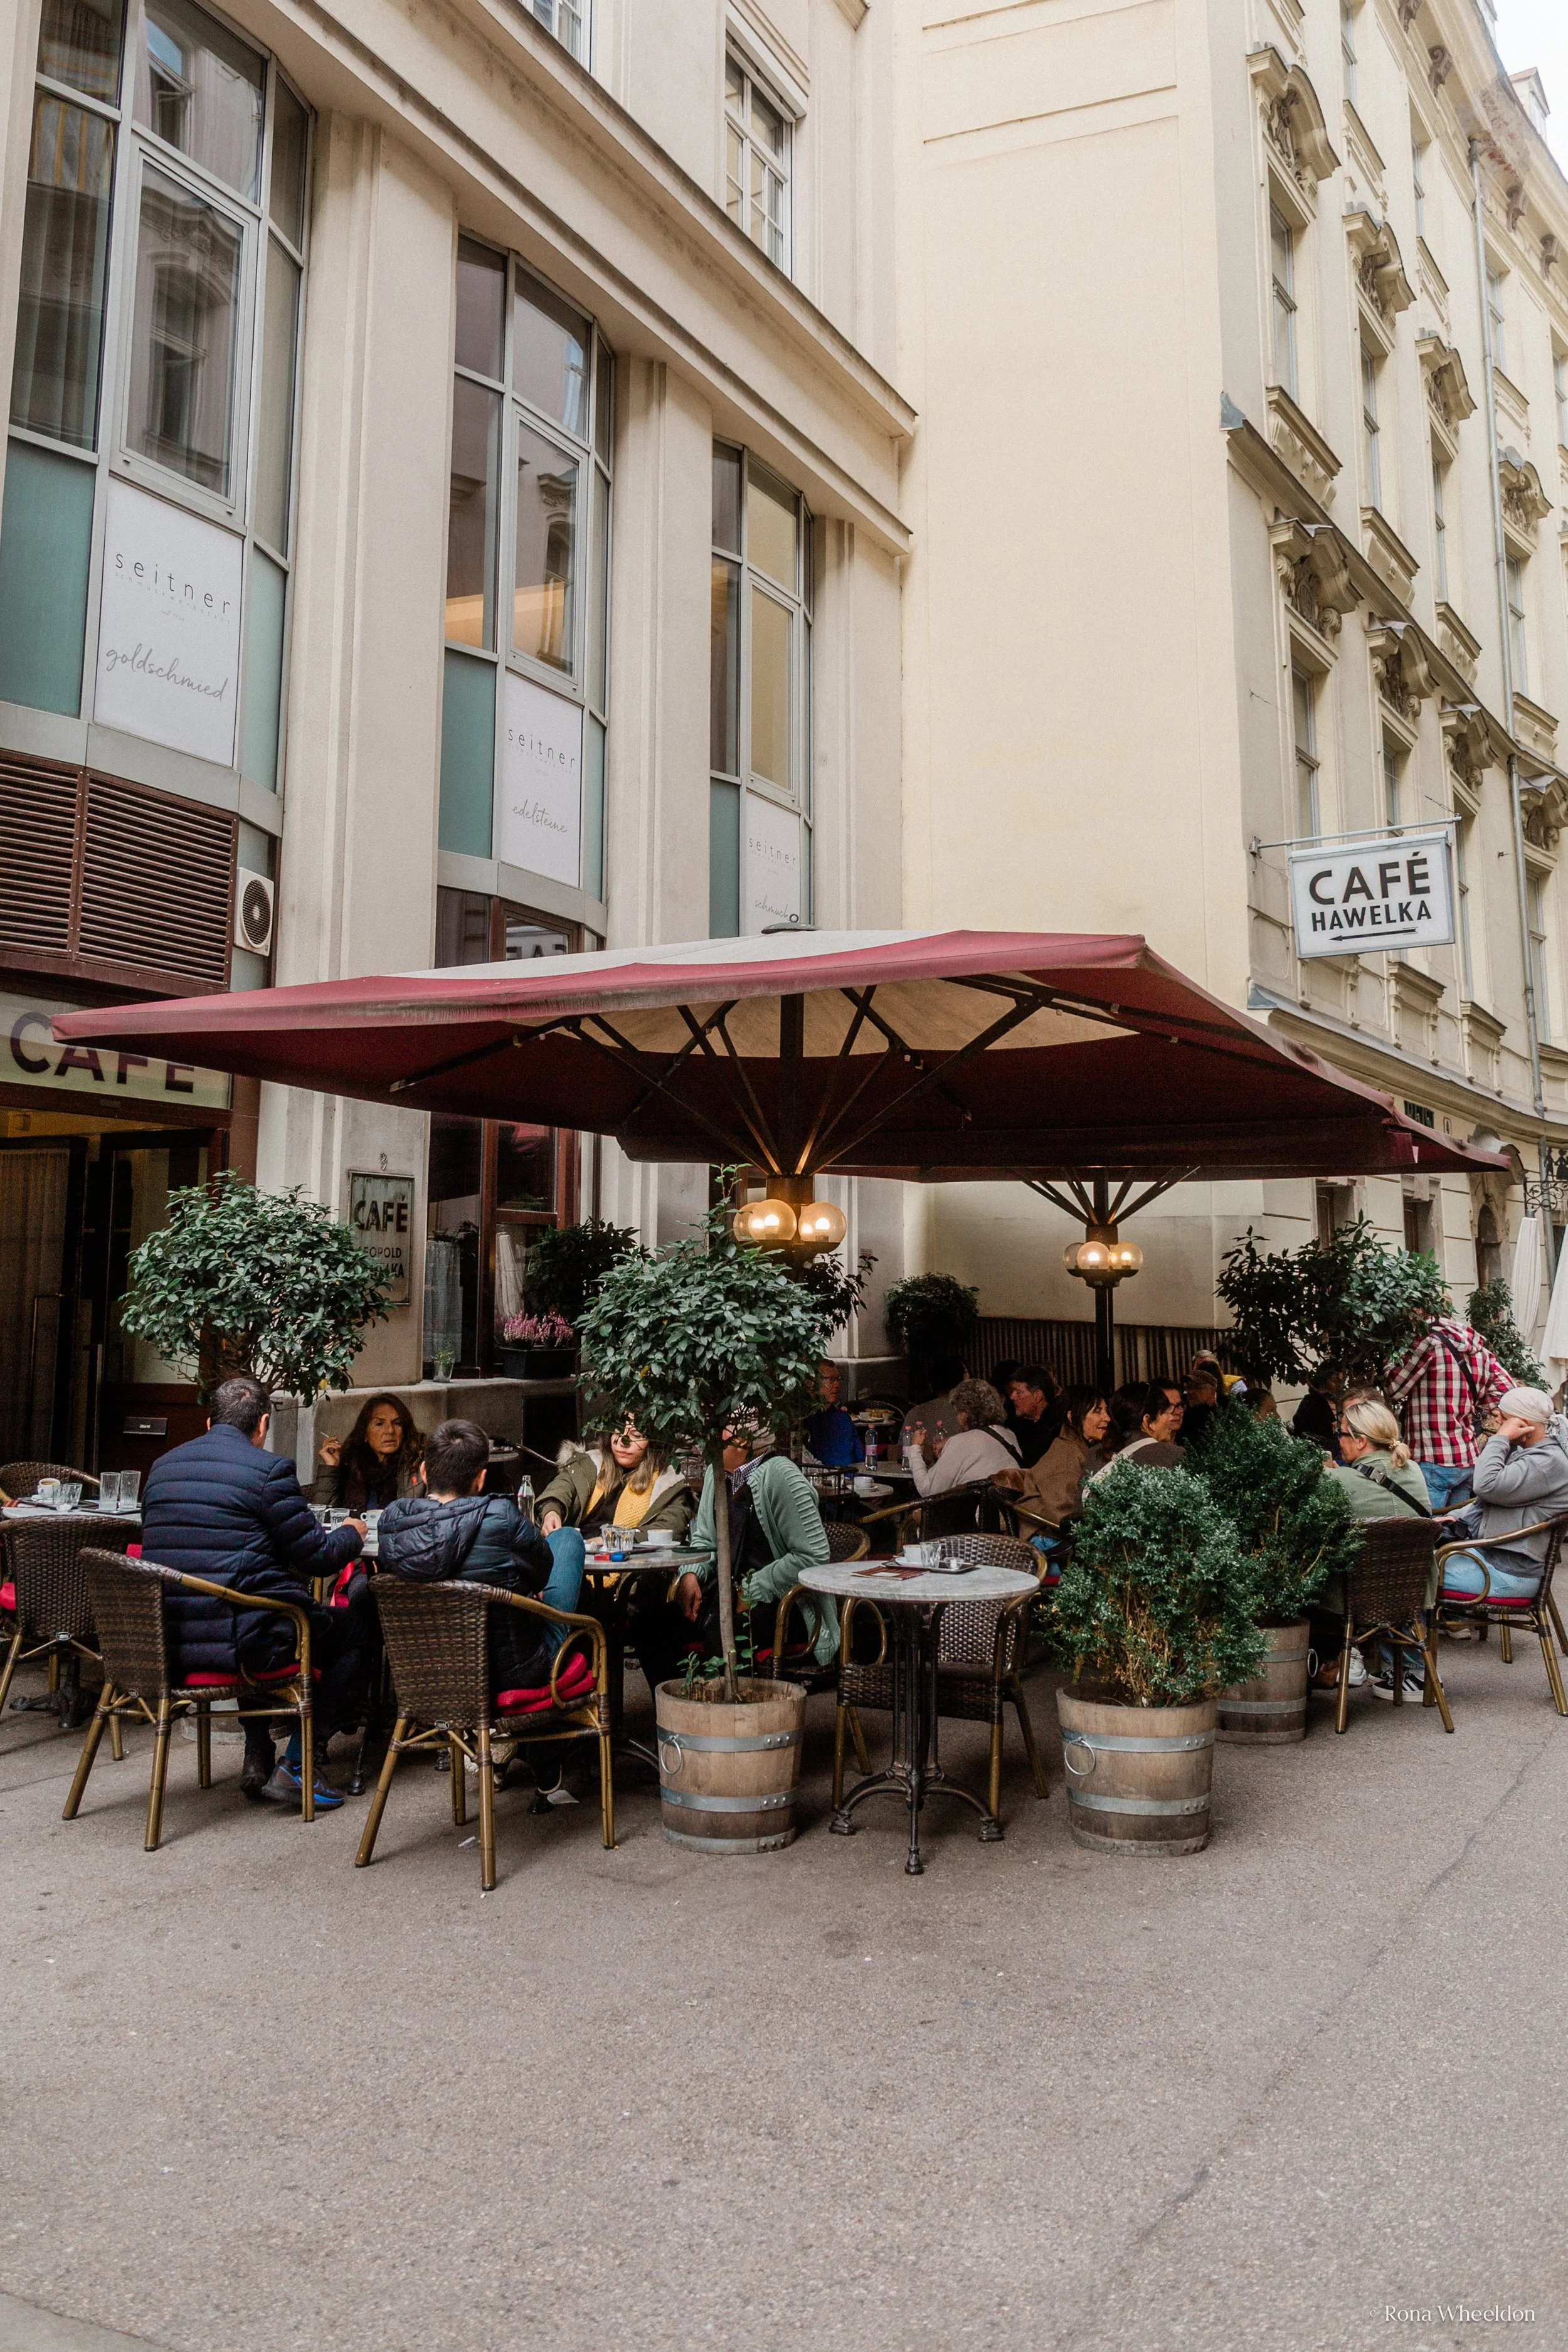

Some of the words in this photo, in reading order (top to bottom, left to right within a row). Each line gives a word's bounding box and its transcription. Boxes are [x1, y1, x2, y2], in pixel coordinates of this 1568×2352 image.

[115, 553, 231, 614] seitner
[106, 643, 228, 702] goldschmied
[508, 729, 575, 768] seitner
[511, 798, 568, 833] edelsteine
[749, 838, 796, 866] seitner
[1309, 851, 1431, 905] CAFÉ
[755, 894, 791, 921] schmuck
[1311, 900, 1432, 932] HAWELKA
[354, 1194, 408, 1232] CAFÉ
[359, 1246, 402, 1258] EOPOLD
